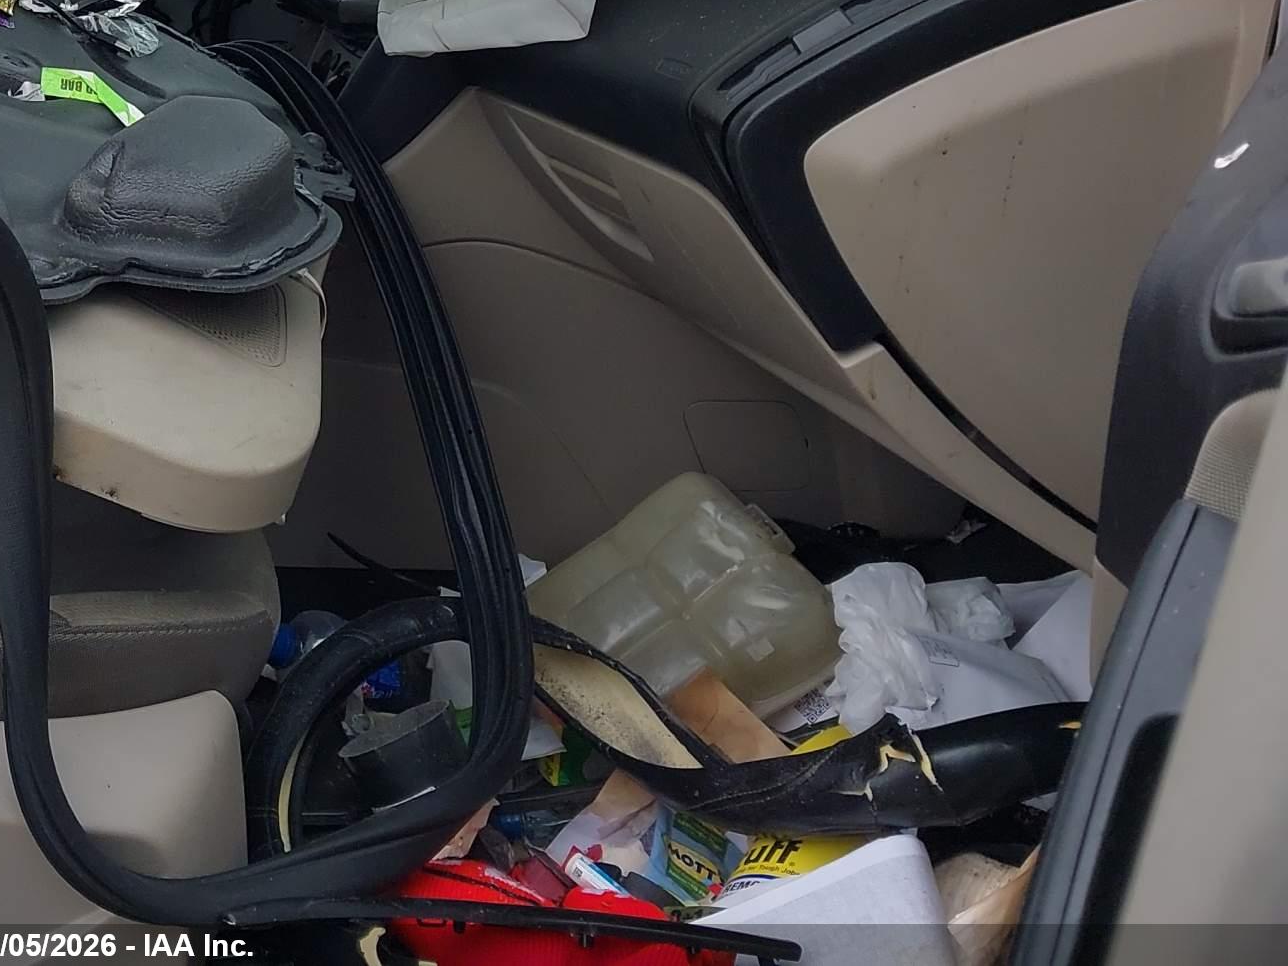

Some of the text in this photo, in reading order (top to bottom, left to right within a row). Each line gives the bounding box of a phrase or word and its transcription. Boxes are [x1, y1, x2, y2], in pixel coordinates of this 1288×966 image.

[60, 77, 83, 93] BAR
[668, 842, 718, 881] MOTT
[744, 840, 803, 865] uff
